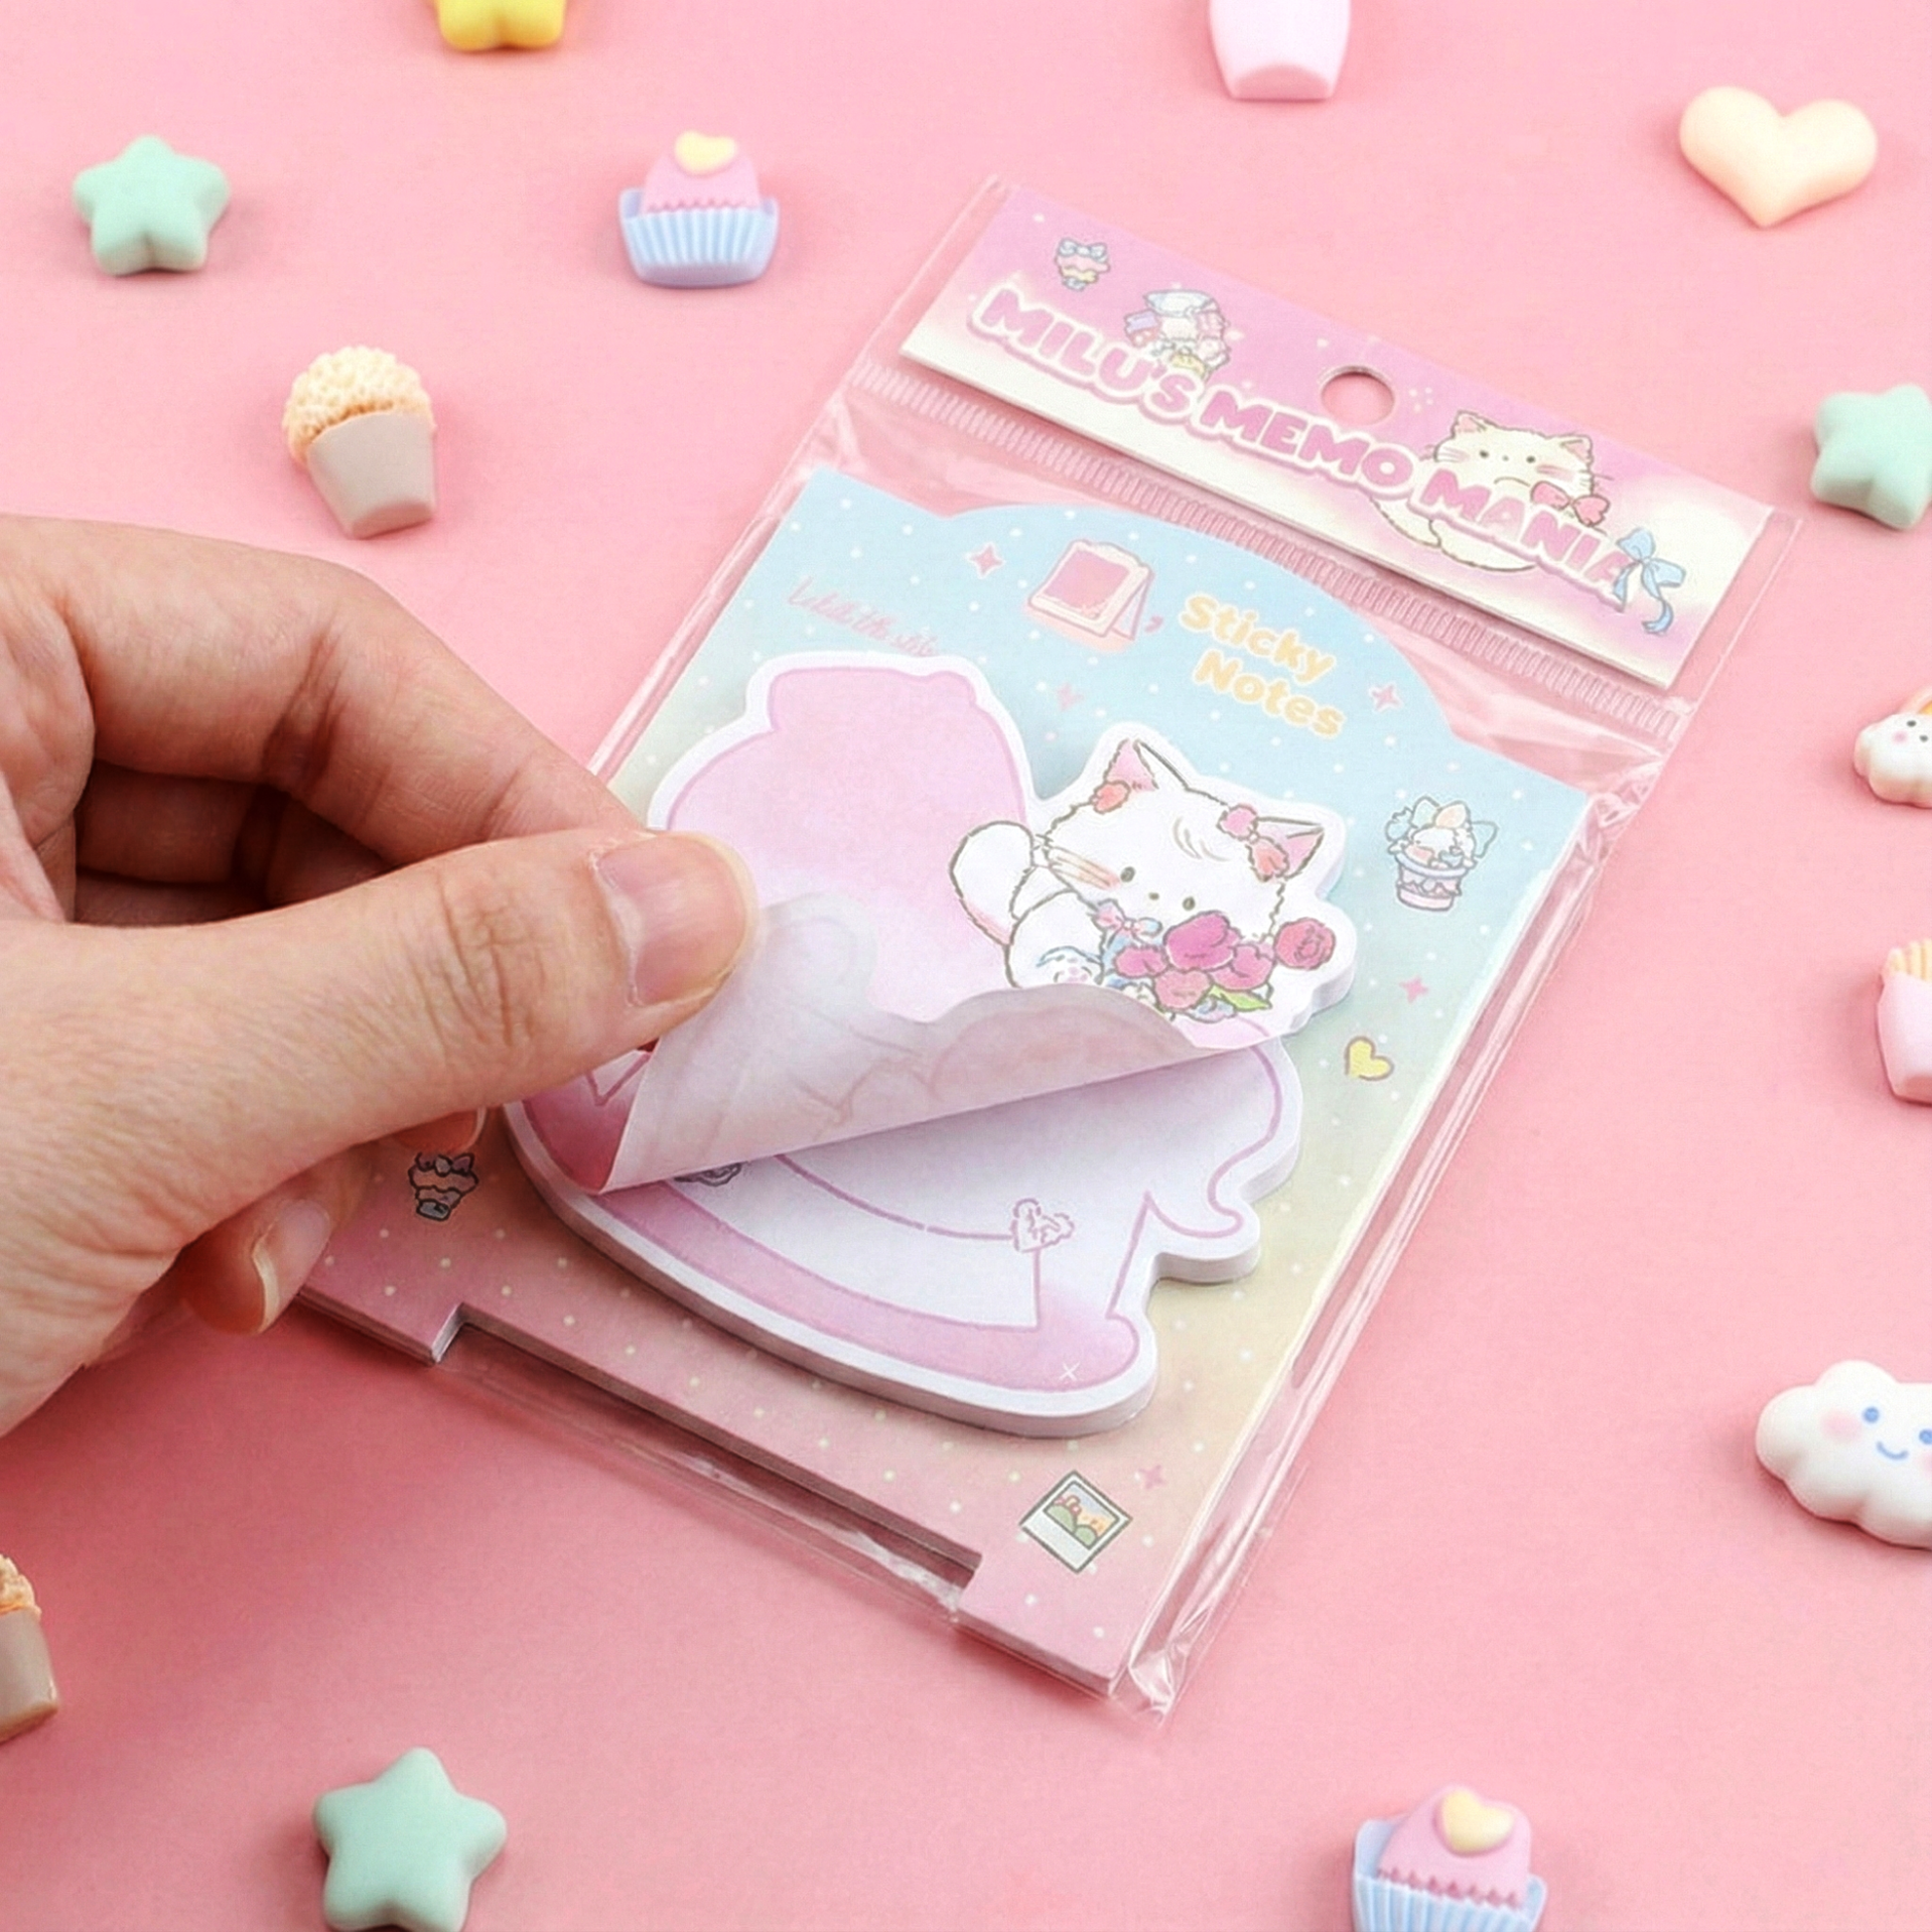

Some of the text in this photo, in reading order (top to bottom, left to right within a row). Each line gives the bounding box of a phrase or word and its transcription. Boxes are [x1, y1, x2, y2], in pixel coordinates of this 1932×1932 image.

[978, 285, 1634, 586] MILU'S MEMO MANIA
[1178, 594, 1336, 683] Sticky
[1192, 648, 1345, 737] Notes
